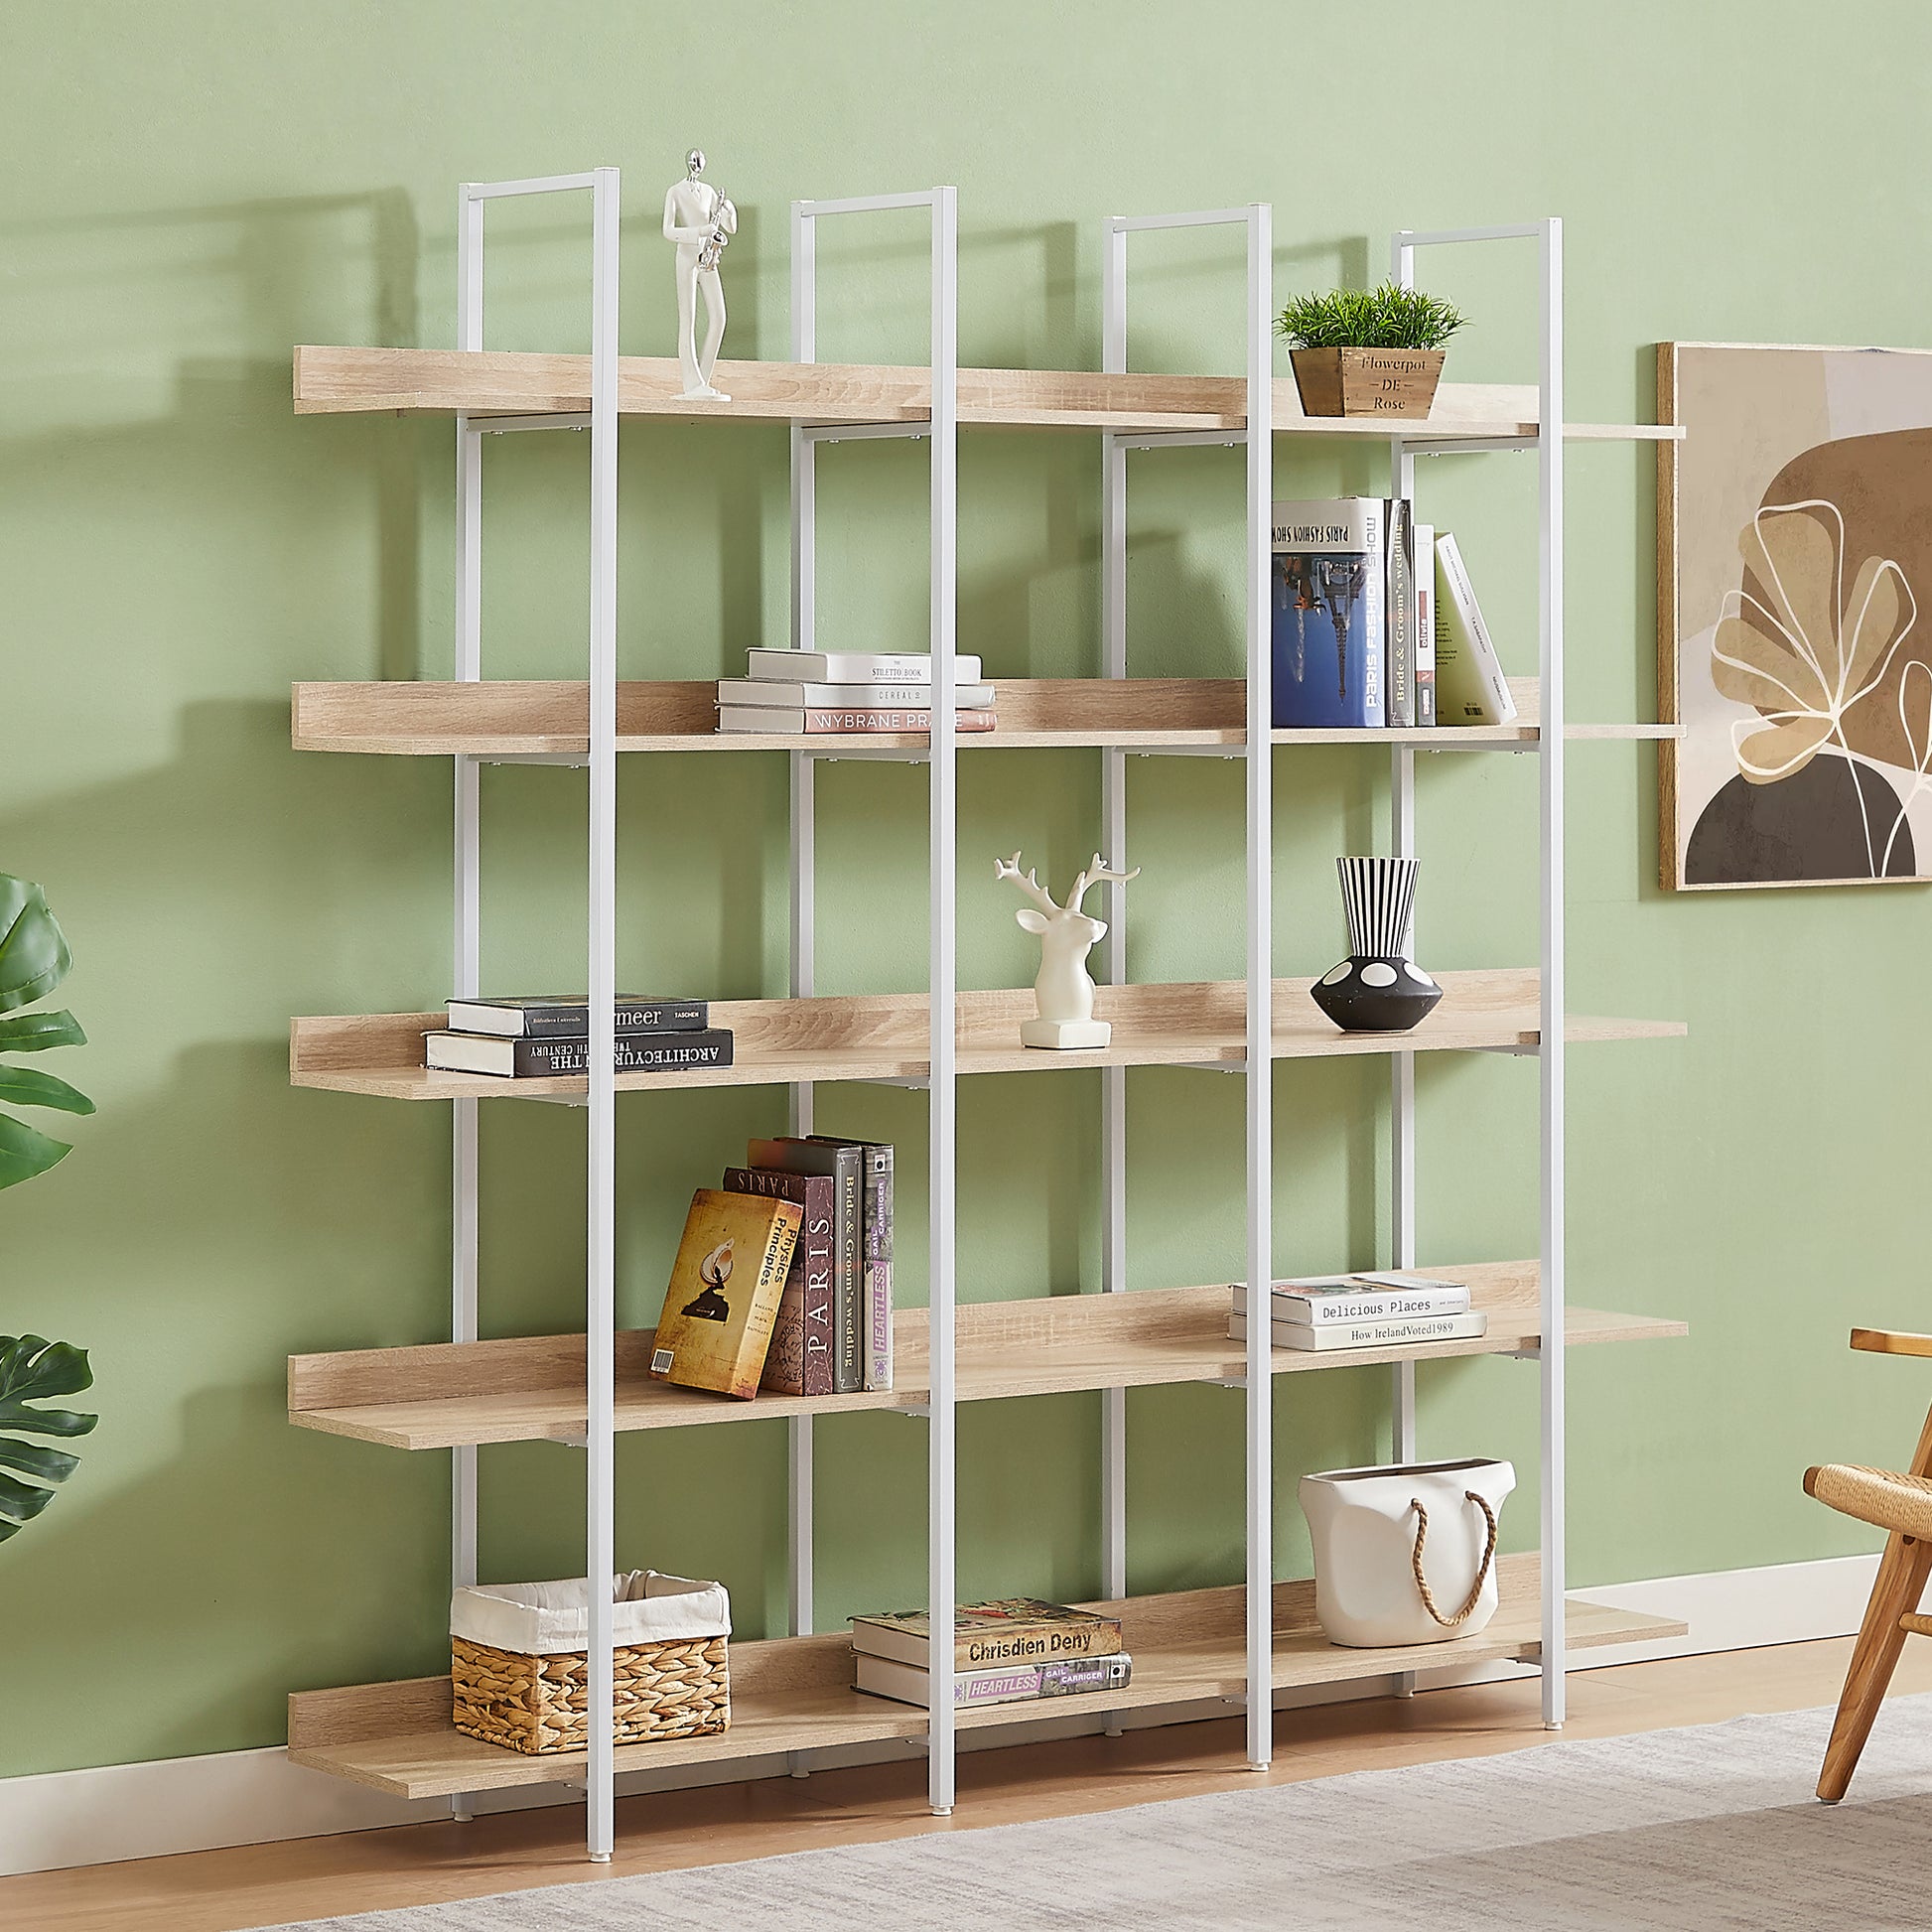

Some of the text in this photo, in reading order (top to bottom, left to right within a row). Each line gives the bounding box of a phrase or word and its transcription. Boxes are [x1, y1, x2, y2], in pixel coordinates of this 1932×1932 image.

[1361, 356, 1426, 373] Flowerpot
[1374, 396, 1406, 410] Rose
[1294, 525, 1324, 542] FASHION
[1326, 525, 1348, 542] PARIS
[1366, 517, 1376, 567] SHOW
[1394, 523, 1405, 701] Bride & Groom's wedding
[903, 668, 922, 677] BOOK
[879, 691, 911, 700] CEREAL
[815, 714, 900, 729] WYBRANE
[906, 714, 963, 728] PRE
[614, 1010, 662, 1026] meer
[530, 1044, 573, 1057] CENTURY
[616, 1046, 720, 1066] ARCHITECYUR
[551, 1054, 586, 1069] THE
[738, 1172, 789, 1196] PARIS
[760, 1217, 787, 1287] Principles
[774, 1228, 797, 1283] Physics
[845, 1174, 855, 1367] Bride & Groom's wedding
[807, 1219, 829, 1353] PARIS
[875, 1265, 886, 1349] HEARTLESS
[1322, 1300, 1432, 1318] Delicious Places
[1351, 1321, 1453, 1341] How IrelandVoted1989
[969, 1633, 1092, 1662] Chrisdien Deny
[971, 1676, 1038, 1696] HEARTLESS
[1061, 1672, 1103, 1683] CARRIGER
